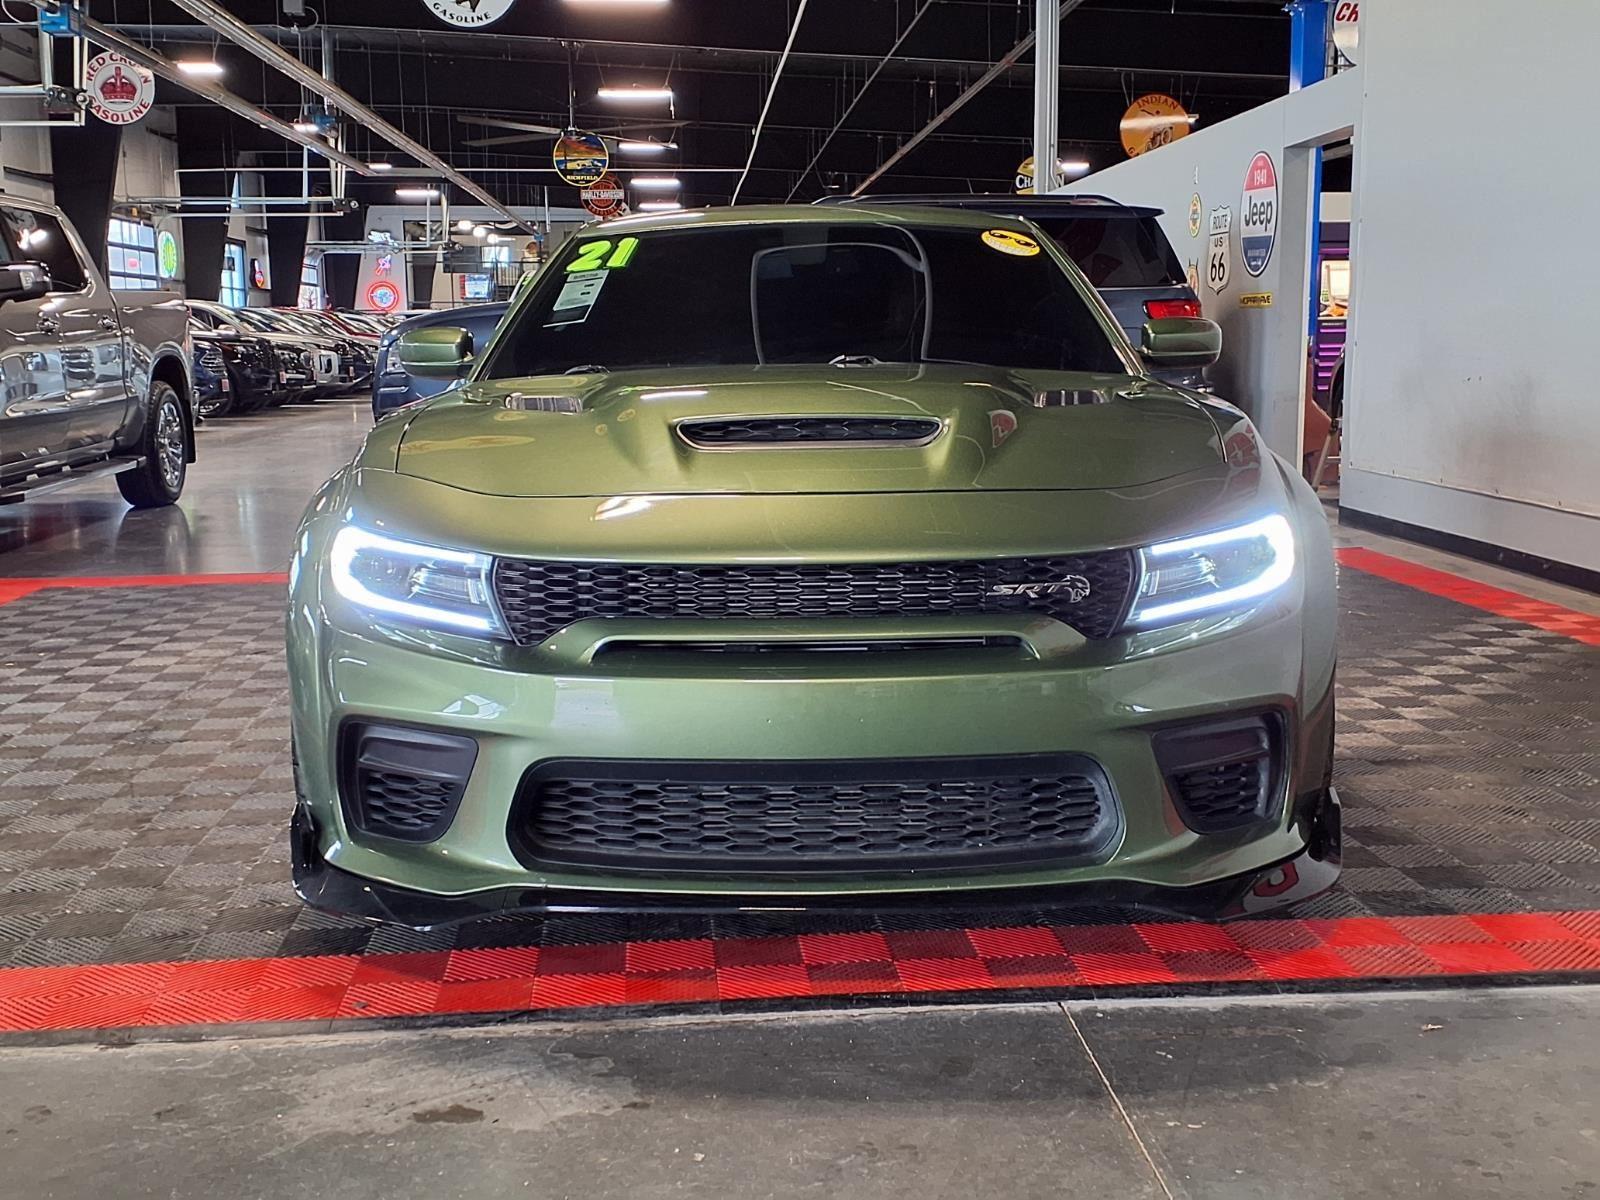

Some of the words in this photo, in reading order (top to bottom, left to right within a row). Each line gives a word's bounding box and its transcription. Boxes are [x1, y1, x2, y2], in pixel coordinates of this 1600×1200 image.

[433, 2, 491, 23] GASOLINE
[86, 57, 106, 82] RED
[1135, 95, 1179, 110] INDIAN
[1253, 168, 1267, 186] 1941
[1212, 214, 1228, 230] ROUTE
[1244, 195, 1273, 233] Jeep
[1214, 236, 1224, 247] US
[565, 237, 639, 272] 21
[1210, 252, 1226, 282] 66
[986, 582, 1071, 598] SRT
